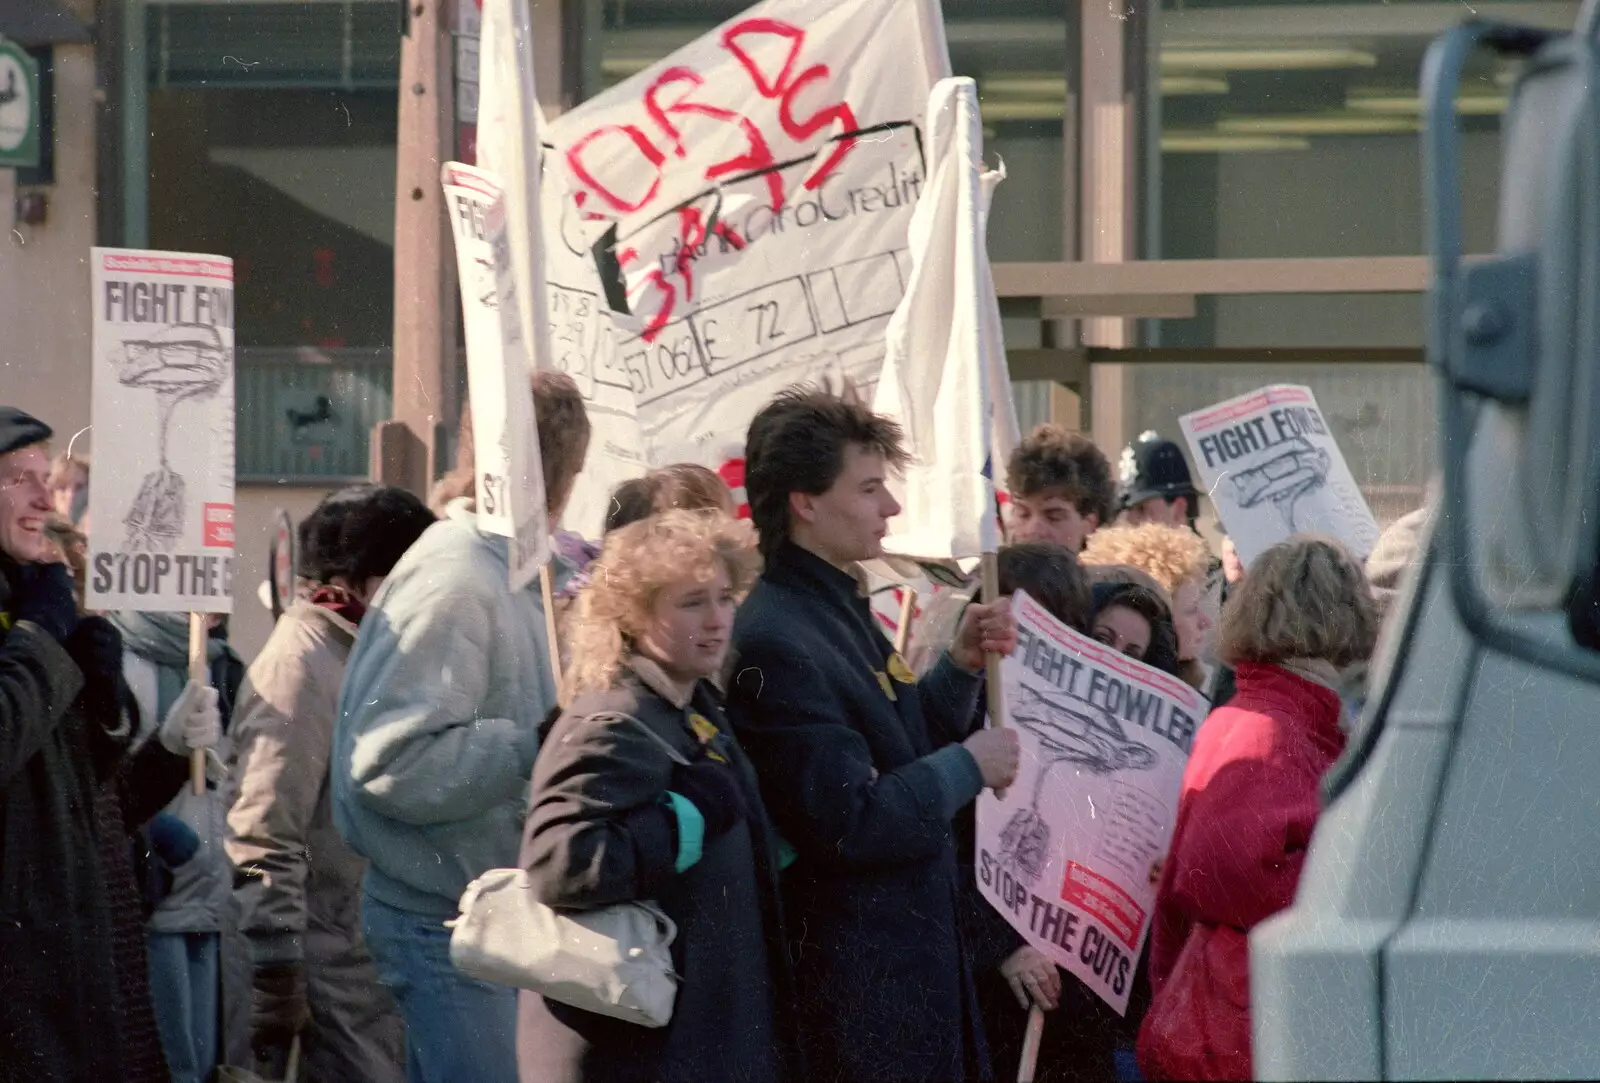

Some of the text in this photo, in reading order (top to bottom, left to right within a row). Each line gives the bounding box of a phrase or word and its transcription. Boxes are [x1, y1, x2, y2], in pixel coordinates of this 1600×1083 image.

[105, 280, 186, 324] FIGHT
[1197, 416, 1267, 468] FIGHT
[92, 551, 170, 595] STOP
[174, 554, 218, 597] THE
[1016, 622, 1084, 694] FIGHT
[1087, 667, 1197, 757] FOWLER
[980, 848, 1028, 917] STOP
[1029, 893, 1079, 953] THE
[1079, 924, 1132, 997] CUTS
